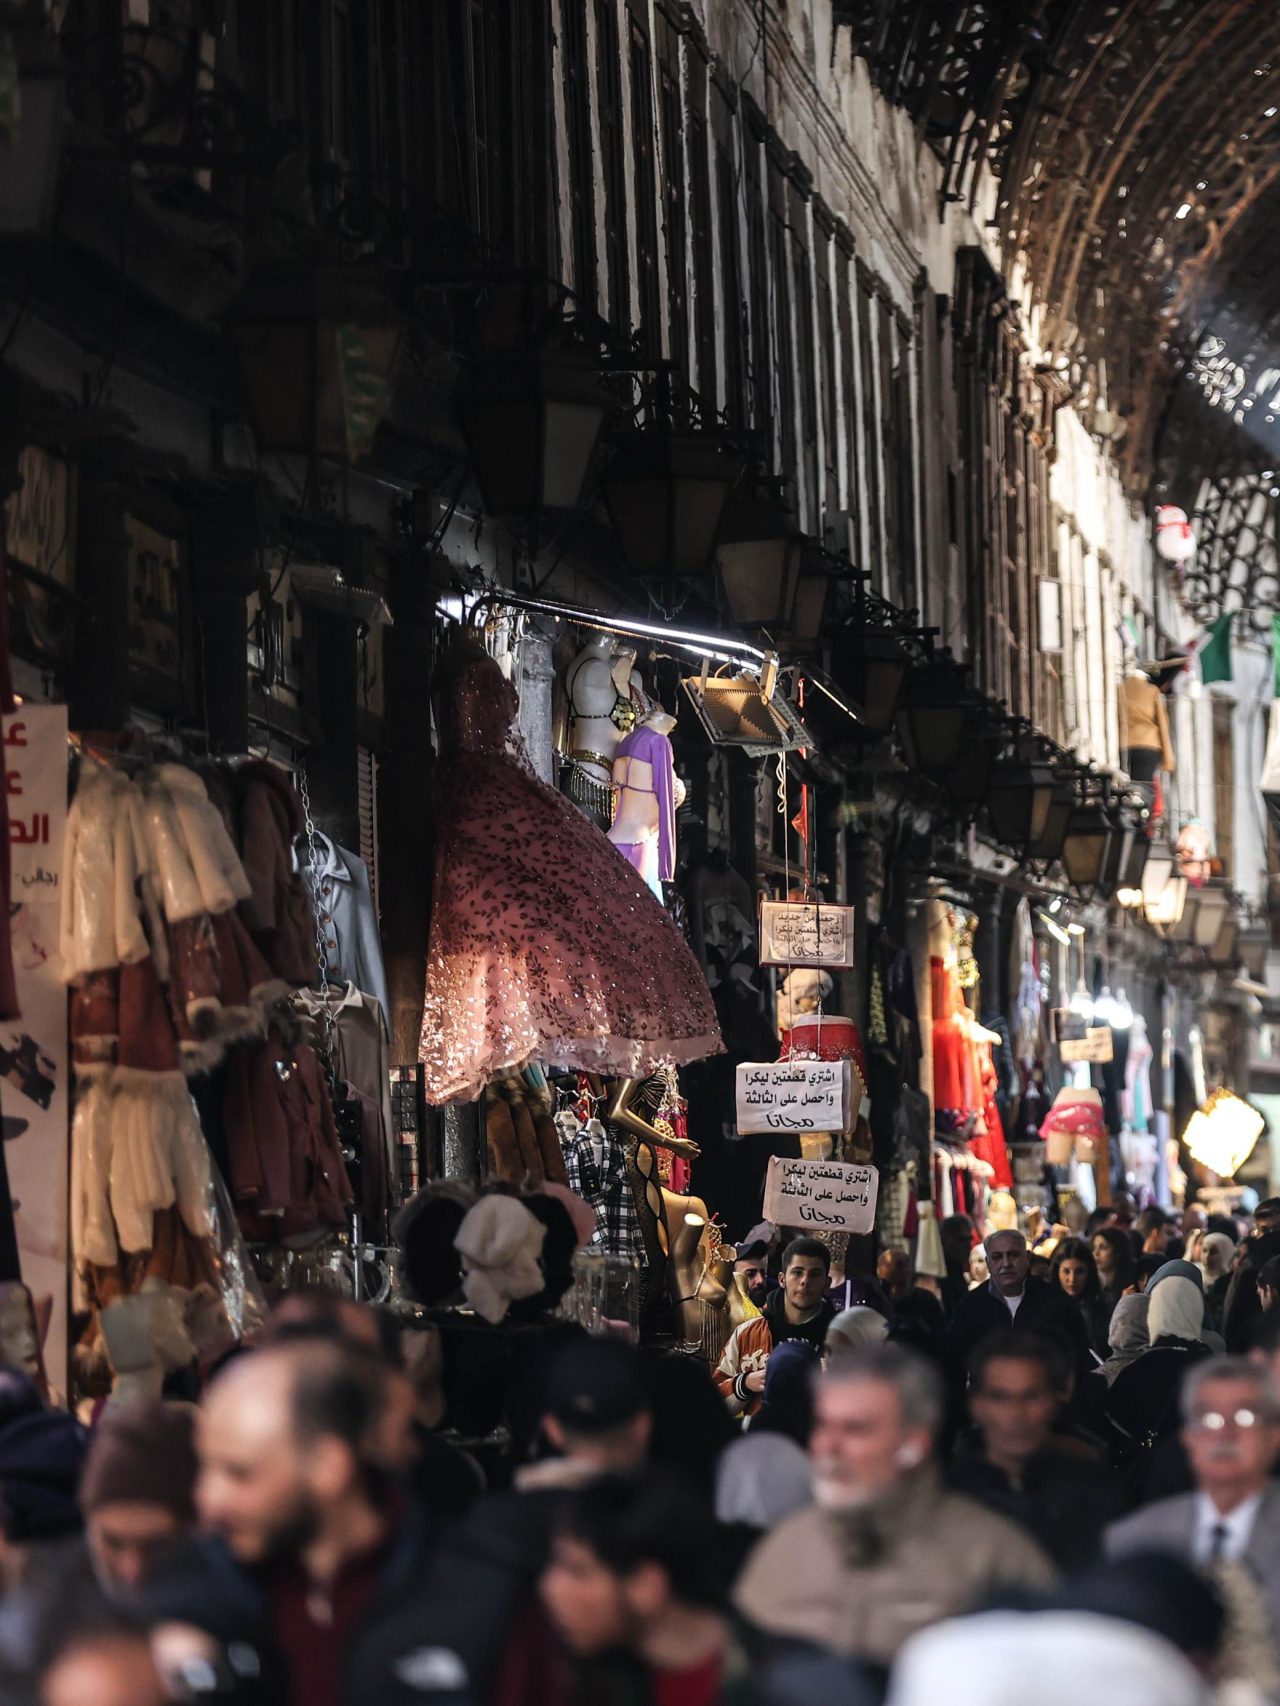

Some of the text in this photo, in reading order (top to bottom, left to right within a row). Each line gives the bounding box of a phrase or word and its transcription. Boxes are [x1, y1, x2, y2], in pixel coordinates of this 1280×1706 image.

[778, 913, 801, 923] جديد
[745, 1072, 769, 1086] ليكرا
[808, 1068, 835, 1086] اشتري
[745, 1089, 834, 1107] واحصل على الثالثة
[783, 1164, 872, 1185] اشتري قطعتين ليكرا
[814, 1189, 833, 1201] على
[836, 1190, 869, 1207] واحصل
